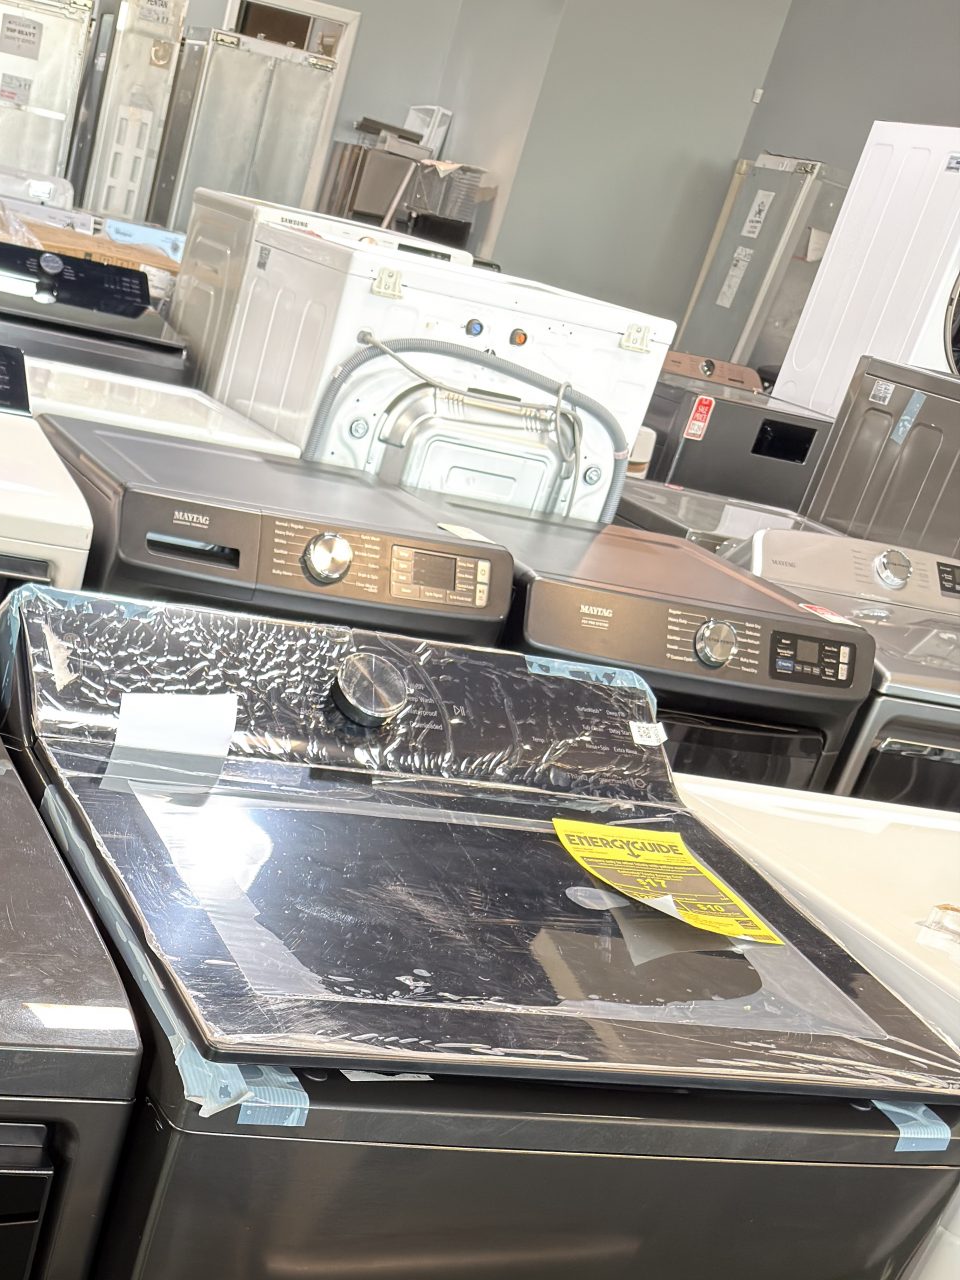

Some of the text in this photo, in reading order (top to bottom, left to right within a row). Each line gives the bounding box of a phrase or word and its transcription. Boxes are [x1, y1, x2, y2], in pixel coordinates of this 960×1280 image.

[280, 216, 308, 228] SAMSUNG
[173, 511, 210, 525] MAYTAG
[580, 604, 613, 617] MAYTAG
[565, 833, 683, 858] ENERGYGUIDE
[635, 878, 667, 890] $17
[696, 903, 725, 912] $10
